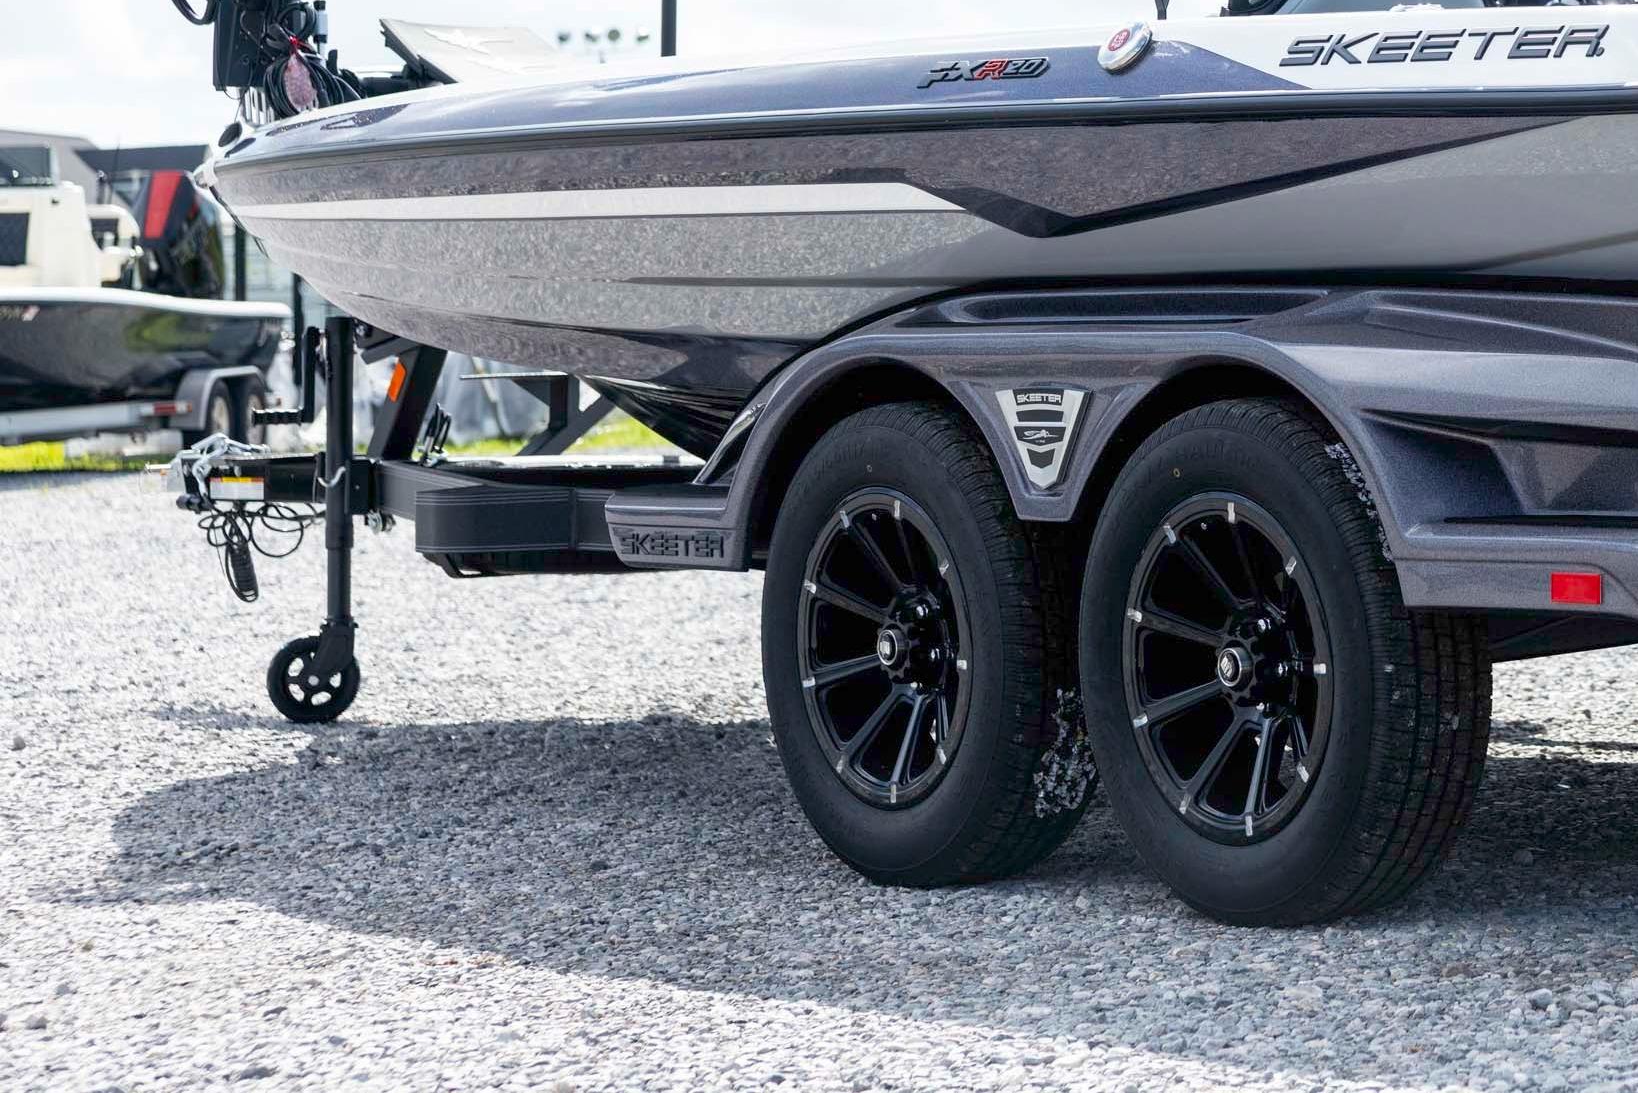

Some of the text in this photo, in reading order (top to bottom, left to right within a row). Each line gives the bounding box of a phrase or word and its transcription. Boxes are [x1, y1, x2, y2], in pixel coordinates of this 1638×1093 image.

[1279, 25, 1610, 67] SKEETER
[1016, 393, 1062, 404] SKEETER
[619, 532, 725, 559] SKEETER
